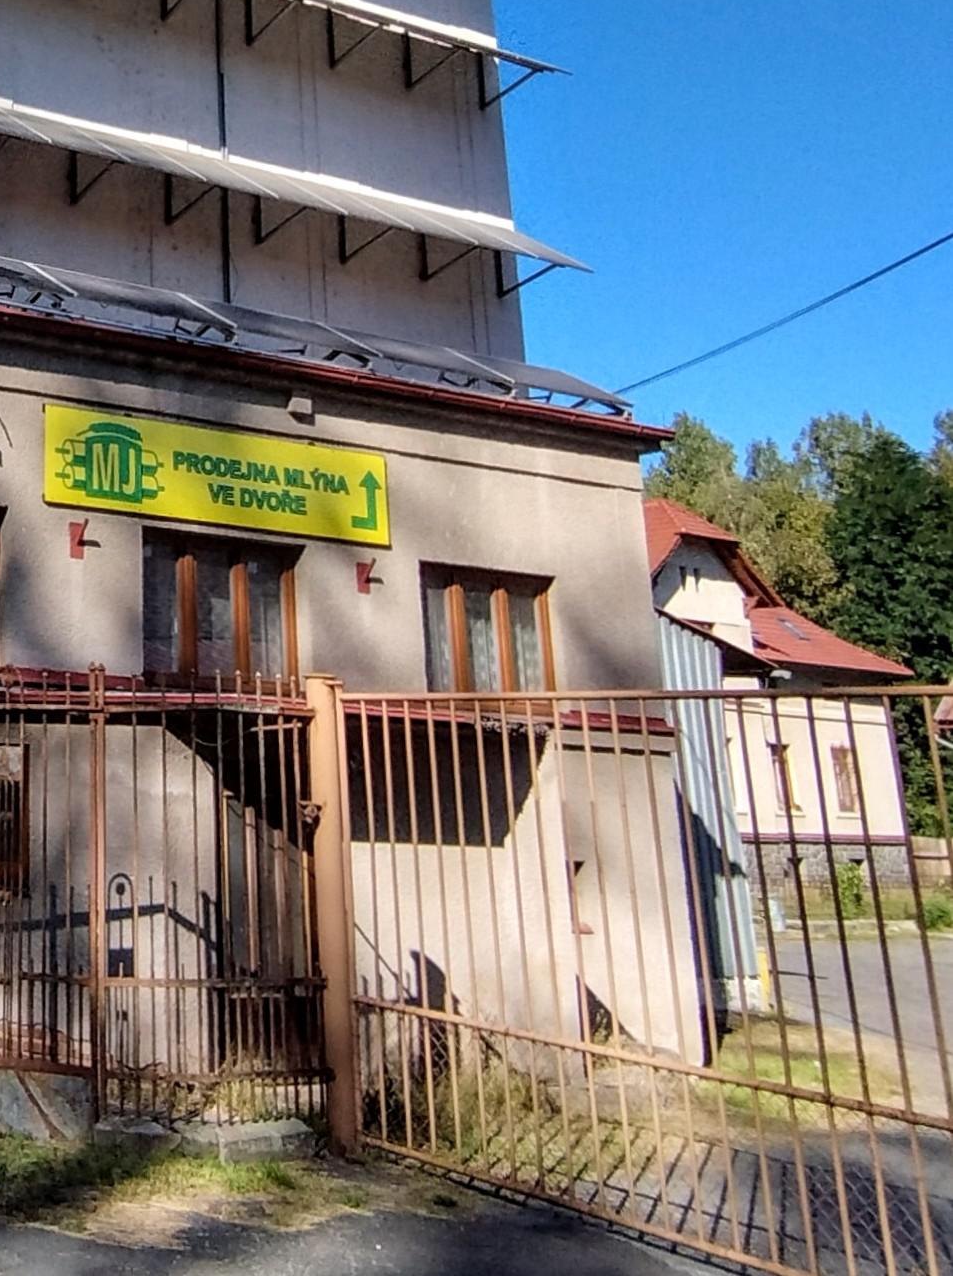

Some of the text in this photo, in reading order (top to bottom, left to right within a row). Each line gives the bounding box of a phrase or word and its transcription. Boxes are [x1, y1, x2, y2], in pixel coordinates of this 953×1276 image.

[92, 442, 136, 495] MJ
[172, 450, 350, 496] PRODEJNA MLÝNA
[208, 483, 307, 516] VE DVOŘE
